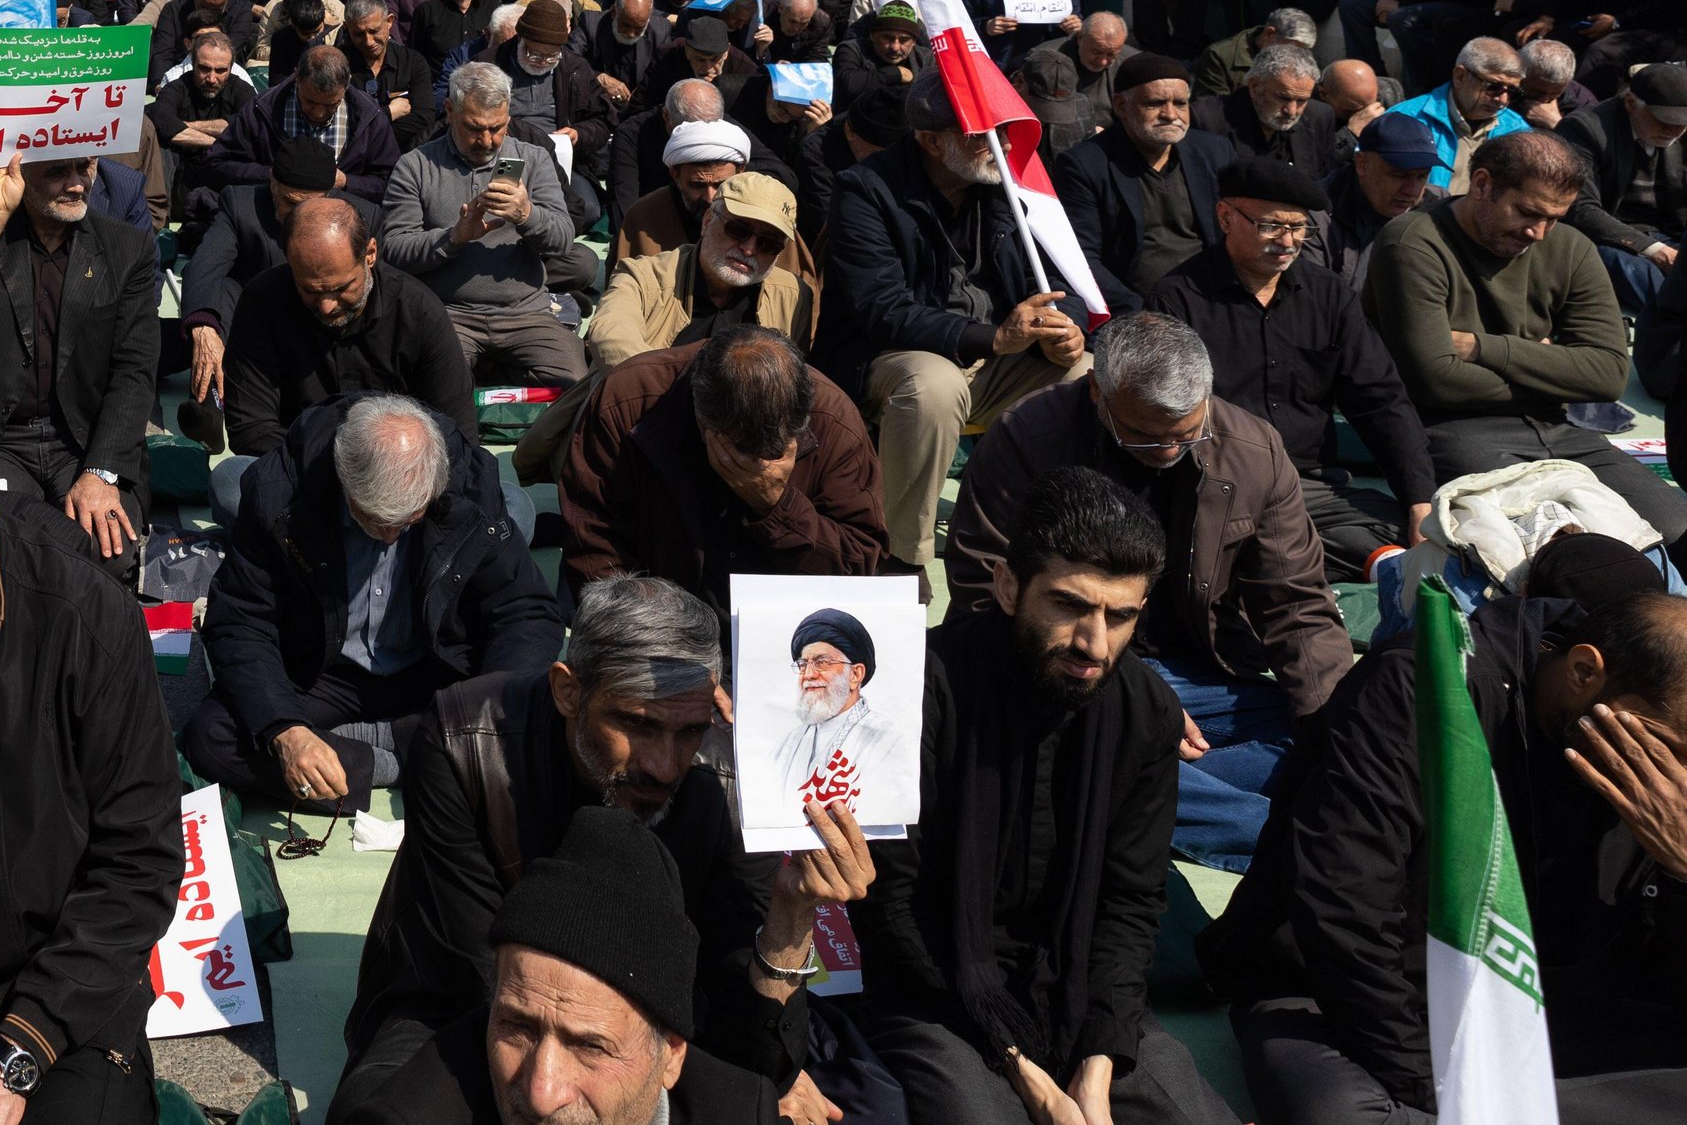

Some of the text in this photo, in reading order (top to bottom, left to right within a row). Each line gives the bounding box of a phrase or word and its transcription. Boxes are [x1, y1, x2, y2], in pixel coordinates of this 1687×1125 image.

[18, 35, 59, 47] نزدیک
[87, 35, 102, 44] به
[30, 50, 55, 62] شدن
[54, 49, 87, 59] خسته
[86, 51, 107, 59] روز
[106, 45, 134, 58] امروز
[22, 54, 31, 62] و
[30, 70, 39, 78] و
[37, 66, 61, 77] امید
[61, 70, 70, 78] و
[69, 66, 95, 76] شوق
[93, 67, 113, 76] روز
[104, 84, 127, 109] تا
[15, 117, 121, 151] ایستاده
[817, 918, 836, 937] می
[828, 938, 856, 966] اتفاق
